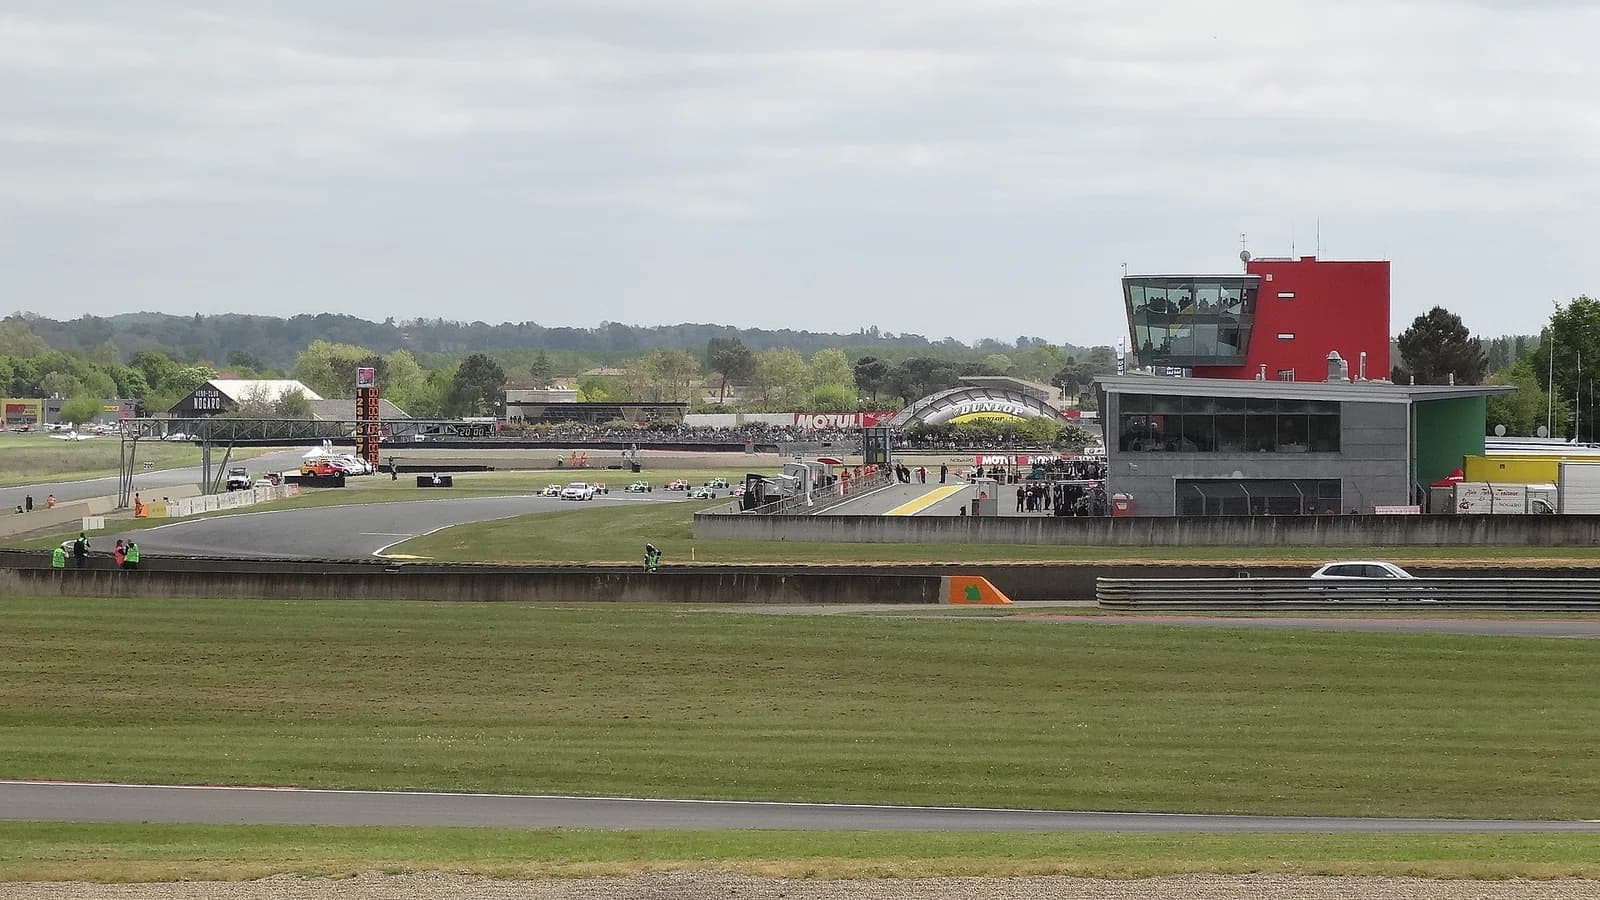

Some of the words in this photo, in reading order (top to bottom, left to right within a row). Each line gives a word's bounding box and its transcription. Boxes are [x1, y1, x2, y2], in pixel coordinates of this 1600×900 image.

[193, 397, 220, 409] NOGARO
[357, 398, 364, 406] 2
[960, 401, 1025, 415] DUNLOP
[357, 407, 364, 415] 3
[796, 414, 859, 429] MOTUL
